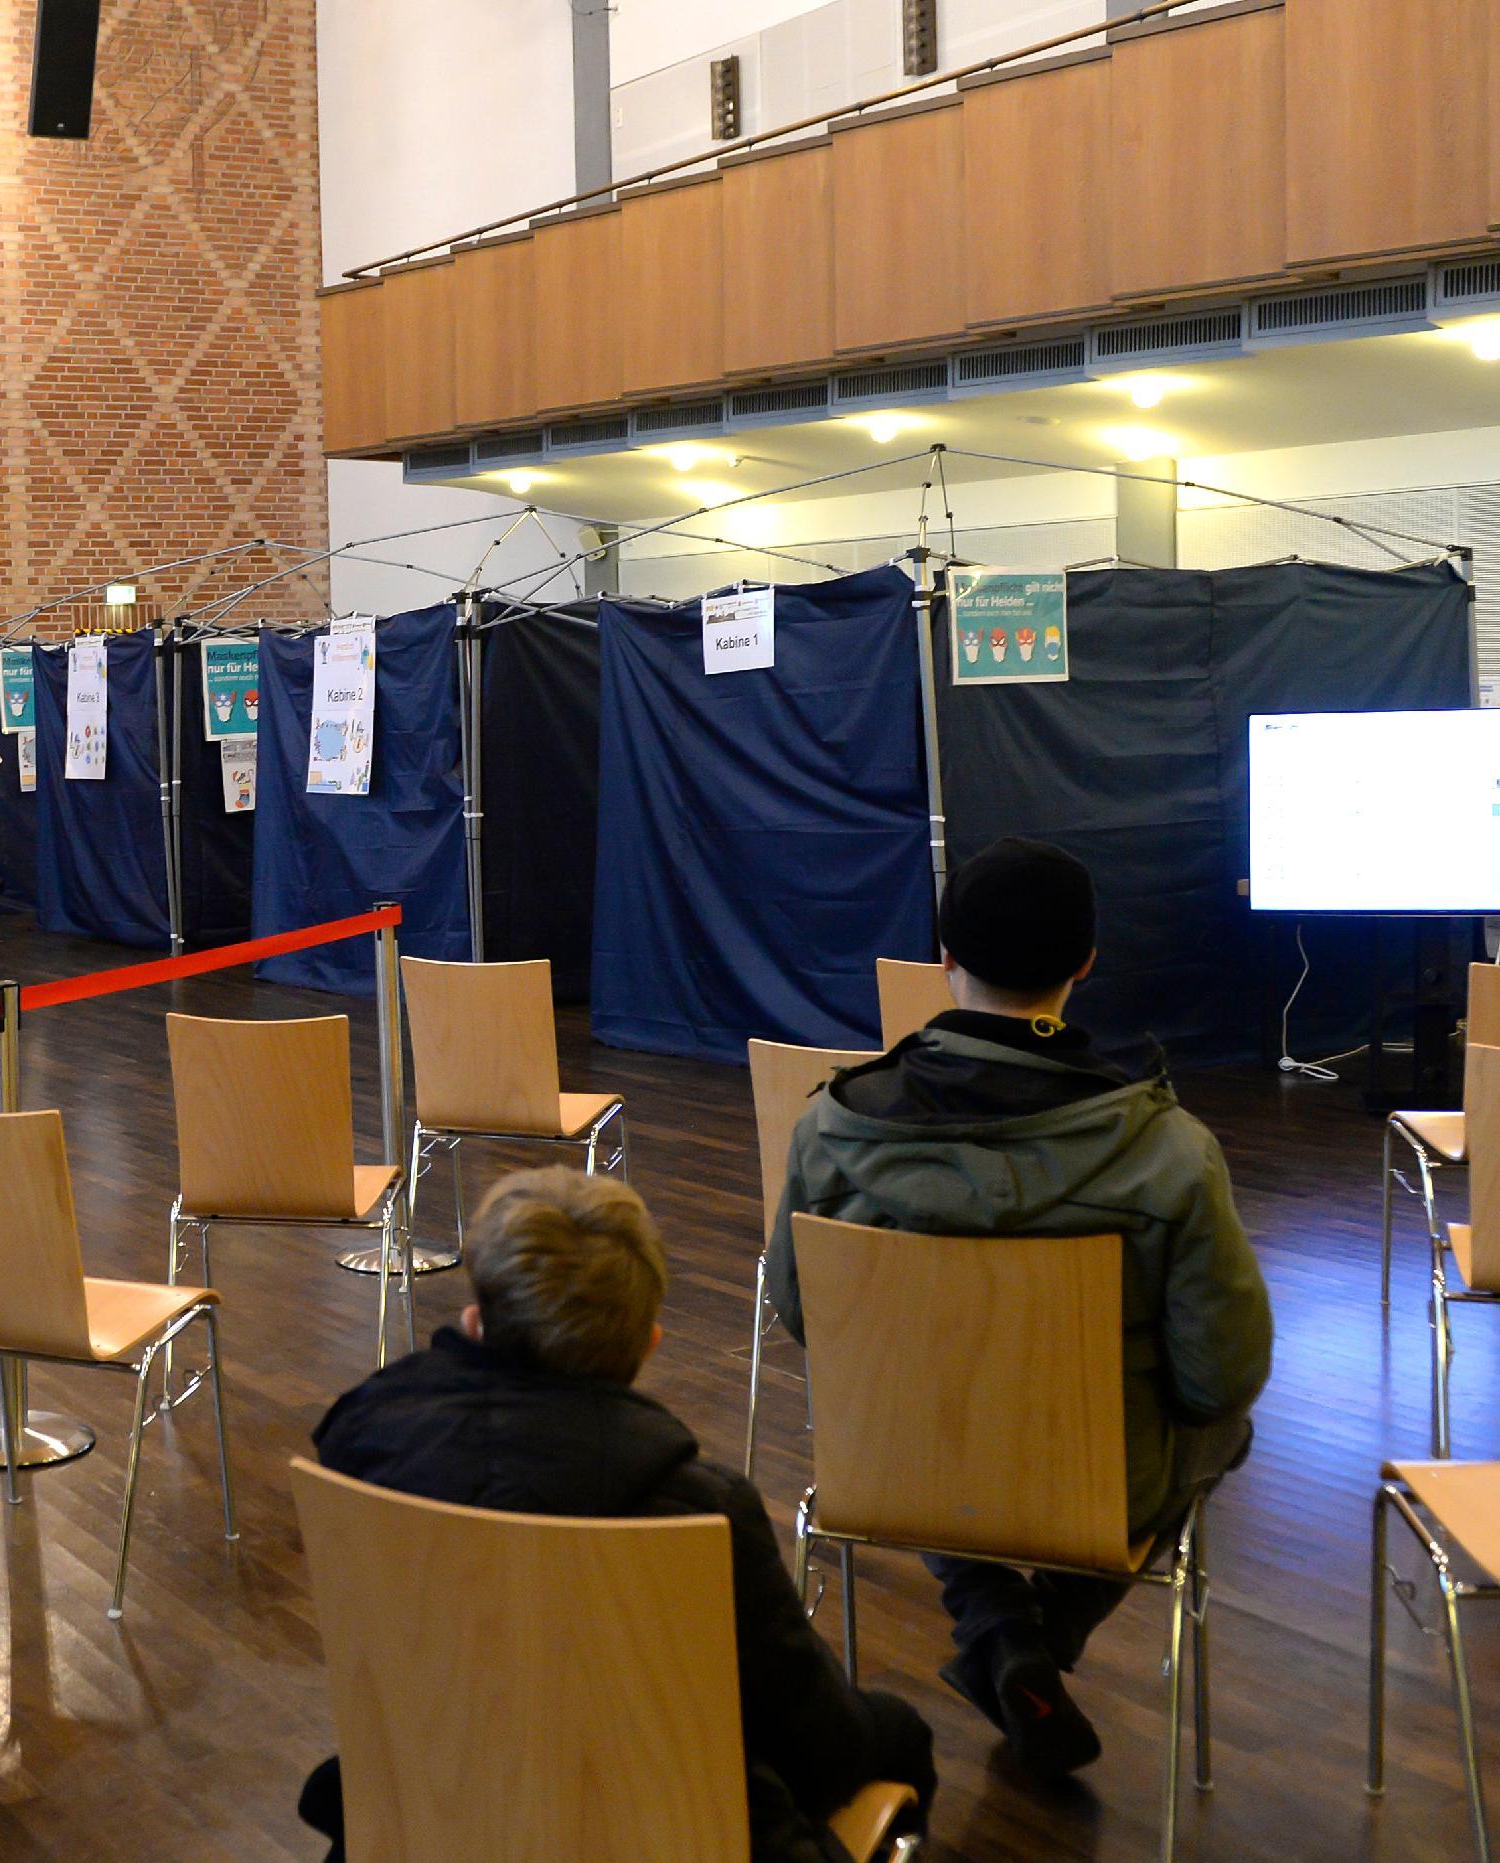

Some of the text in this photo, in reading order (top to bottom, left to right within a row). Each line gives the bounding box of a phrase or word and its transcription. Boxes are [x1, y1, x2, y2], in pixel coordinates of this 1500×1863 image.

[975, 596, 989, 607] für
[990, 596, 1025, 607] Helden
[715, 633, 758, 650] Kabine 1
[207, 665, 226, 673] nur
[226, 662, 242, 673] für
[327, 687, 364, 703] Kabine 2
